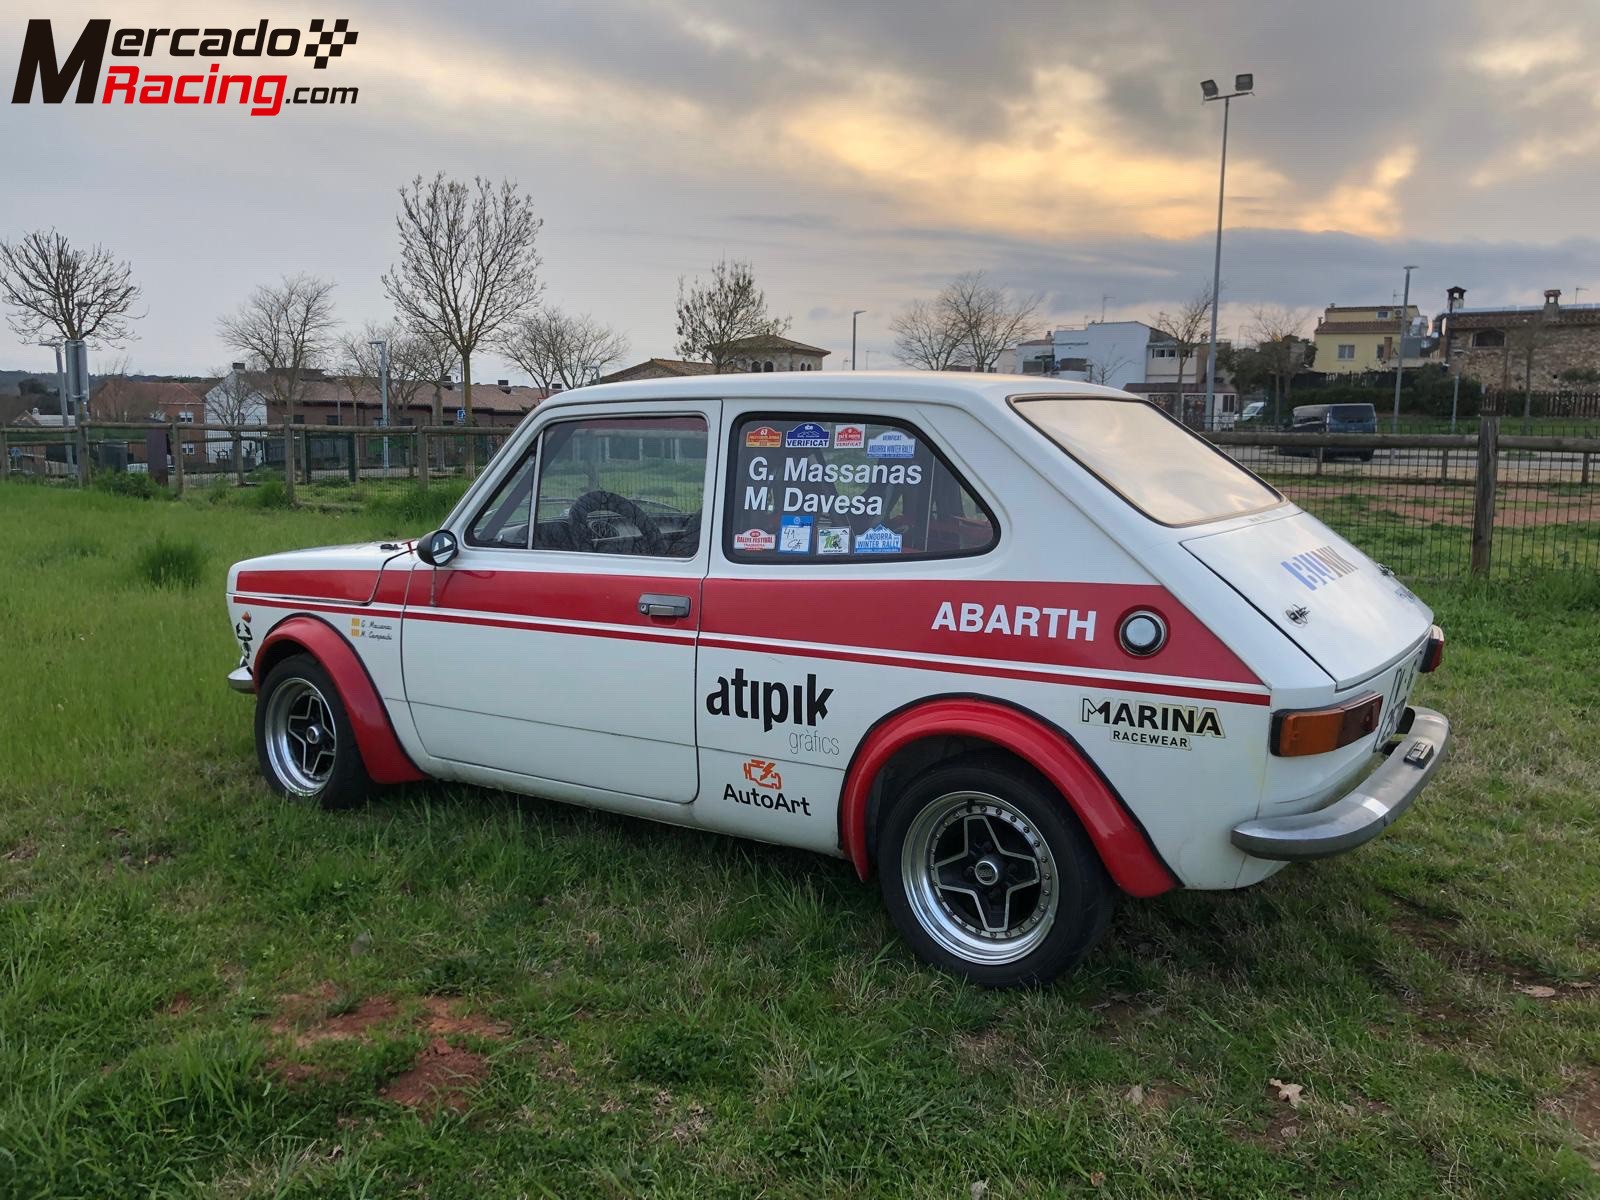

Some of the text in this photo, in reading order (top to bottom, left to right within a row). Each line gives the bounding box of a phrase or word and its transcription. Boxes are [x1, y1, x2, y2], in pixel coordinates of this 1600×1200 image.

[786, 439, 829, 447] VERIFICAT
[749, 456, 923, 485] G. Massanas
[744, 486, 883, 516] M. Davesa
[865, 532, 893, 541] ANDORRA
[882, 540, 900, 549] RALLY
[931, 601, 1097, 641] ABARTH
[1082, 698, 1222, 736] MARINA
[1113, 730, 1188, 748] RACEWEAR
[723, 783, 811, 817] AutoArt
